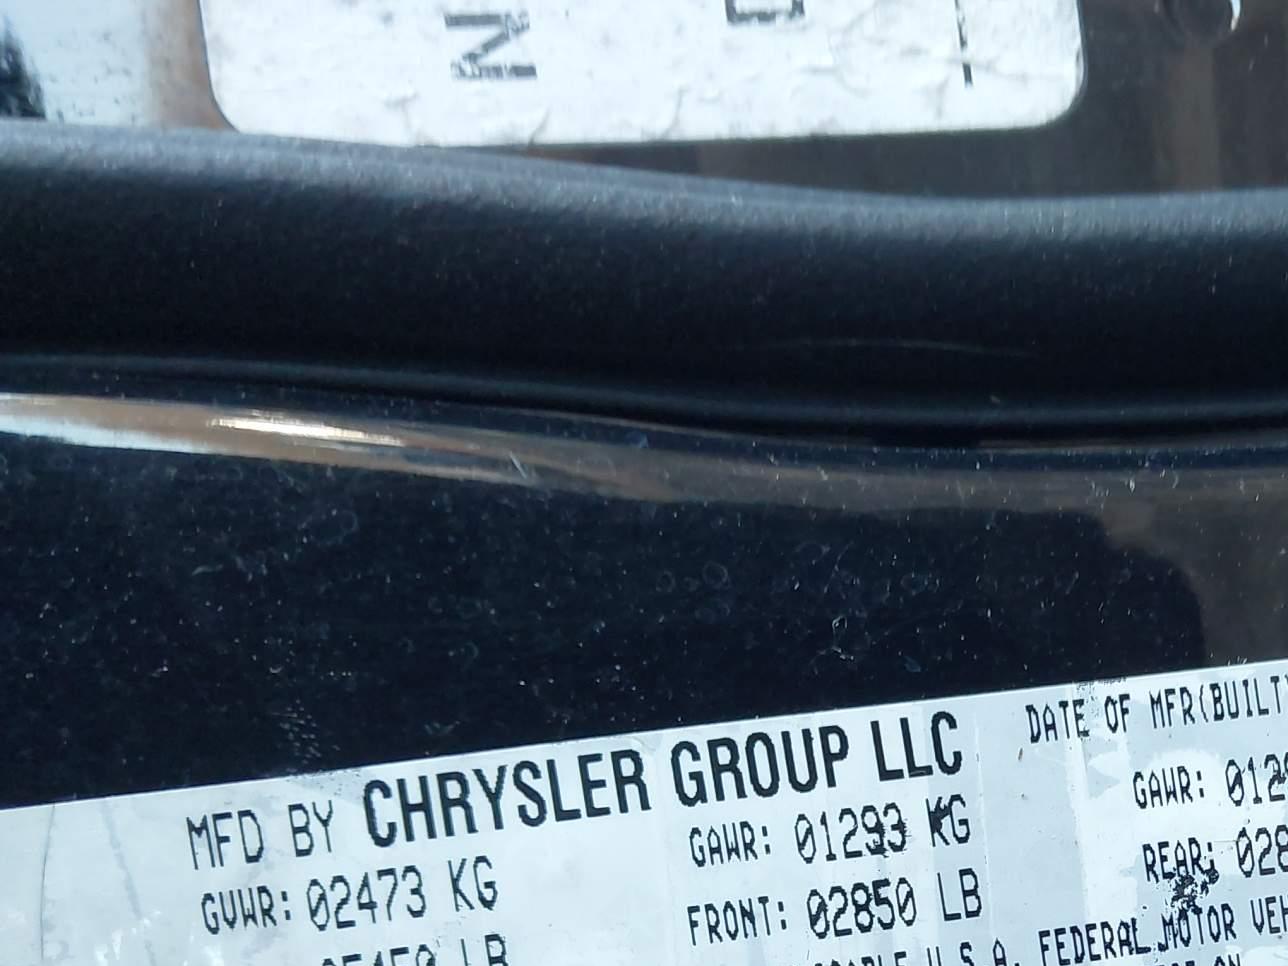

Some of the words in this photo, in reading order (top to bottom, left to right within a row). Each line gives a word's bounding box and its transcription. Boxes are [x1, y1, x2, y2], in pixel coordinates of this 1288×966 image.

[1025, 699, 1089, 743] DATE
[1104, 692, 1131, 734] OF
[186, 809, 264, 870] MFD
[287, 800, 334, 857] BY
[362, 748, 651, 848] CHRYSLER
[670, 724, 849, 807] GROUP
[872, 710, 963, 781] LLC
[1132, 765, 1205, 809] GAWR:
[689, 821, 771, 867] GAWR:
[795, 802, 908, 864] 01293
[926, 794, 971, 847] KG
[1143, 837, 1216, 883] REAR:
[201, 885, 291, 935] GVWR:
[307, 865, 427, 931] 02473
[448, 856, 498, 912] KG
[687, 896, 787, 946] FRONT:
[807, 877, 917, 939] 02850
[937, 868, 981, 921] LB
[1160, 903, 1236, 952] MOTOR
